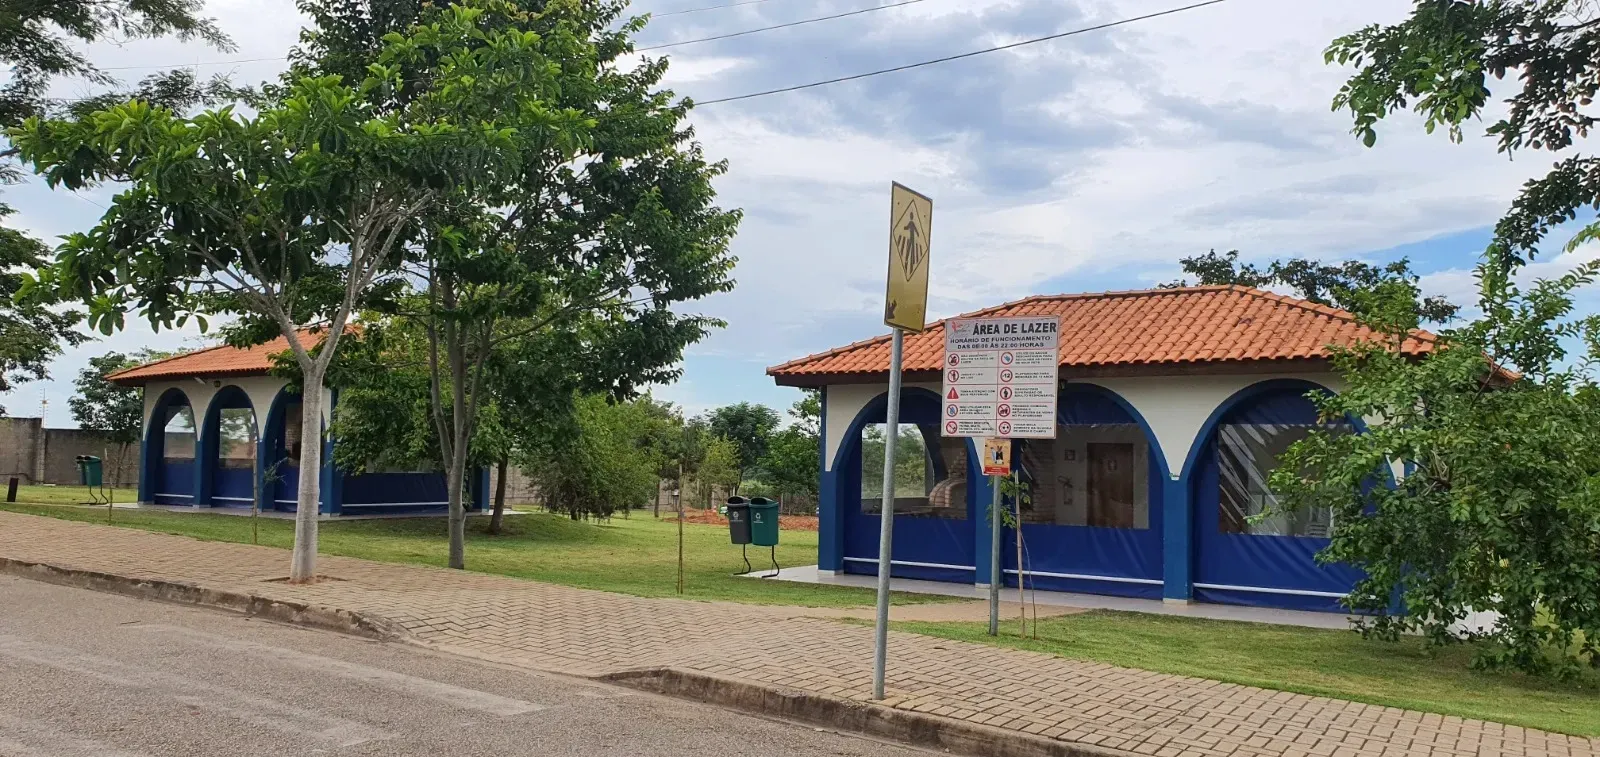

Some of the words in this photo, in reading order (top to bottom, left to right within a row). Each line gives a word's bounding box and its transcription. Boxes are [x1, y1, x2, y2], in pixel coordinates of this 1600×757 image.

[973, 323, 1000, 335] ÁREA
[1004, 323, 1018, 334] DE
[1021, 322, 1057, 334] LAZER
